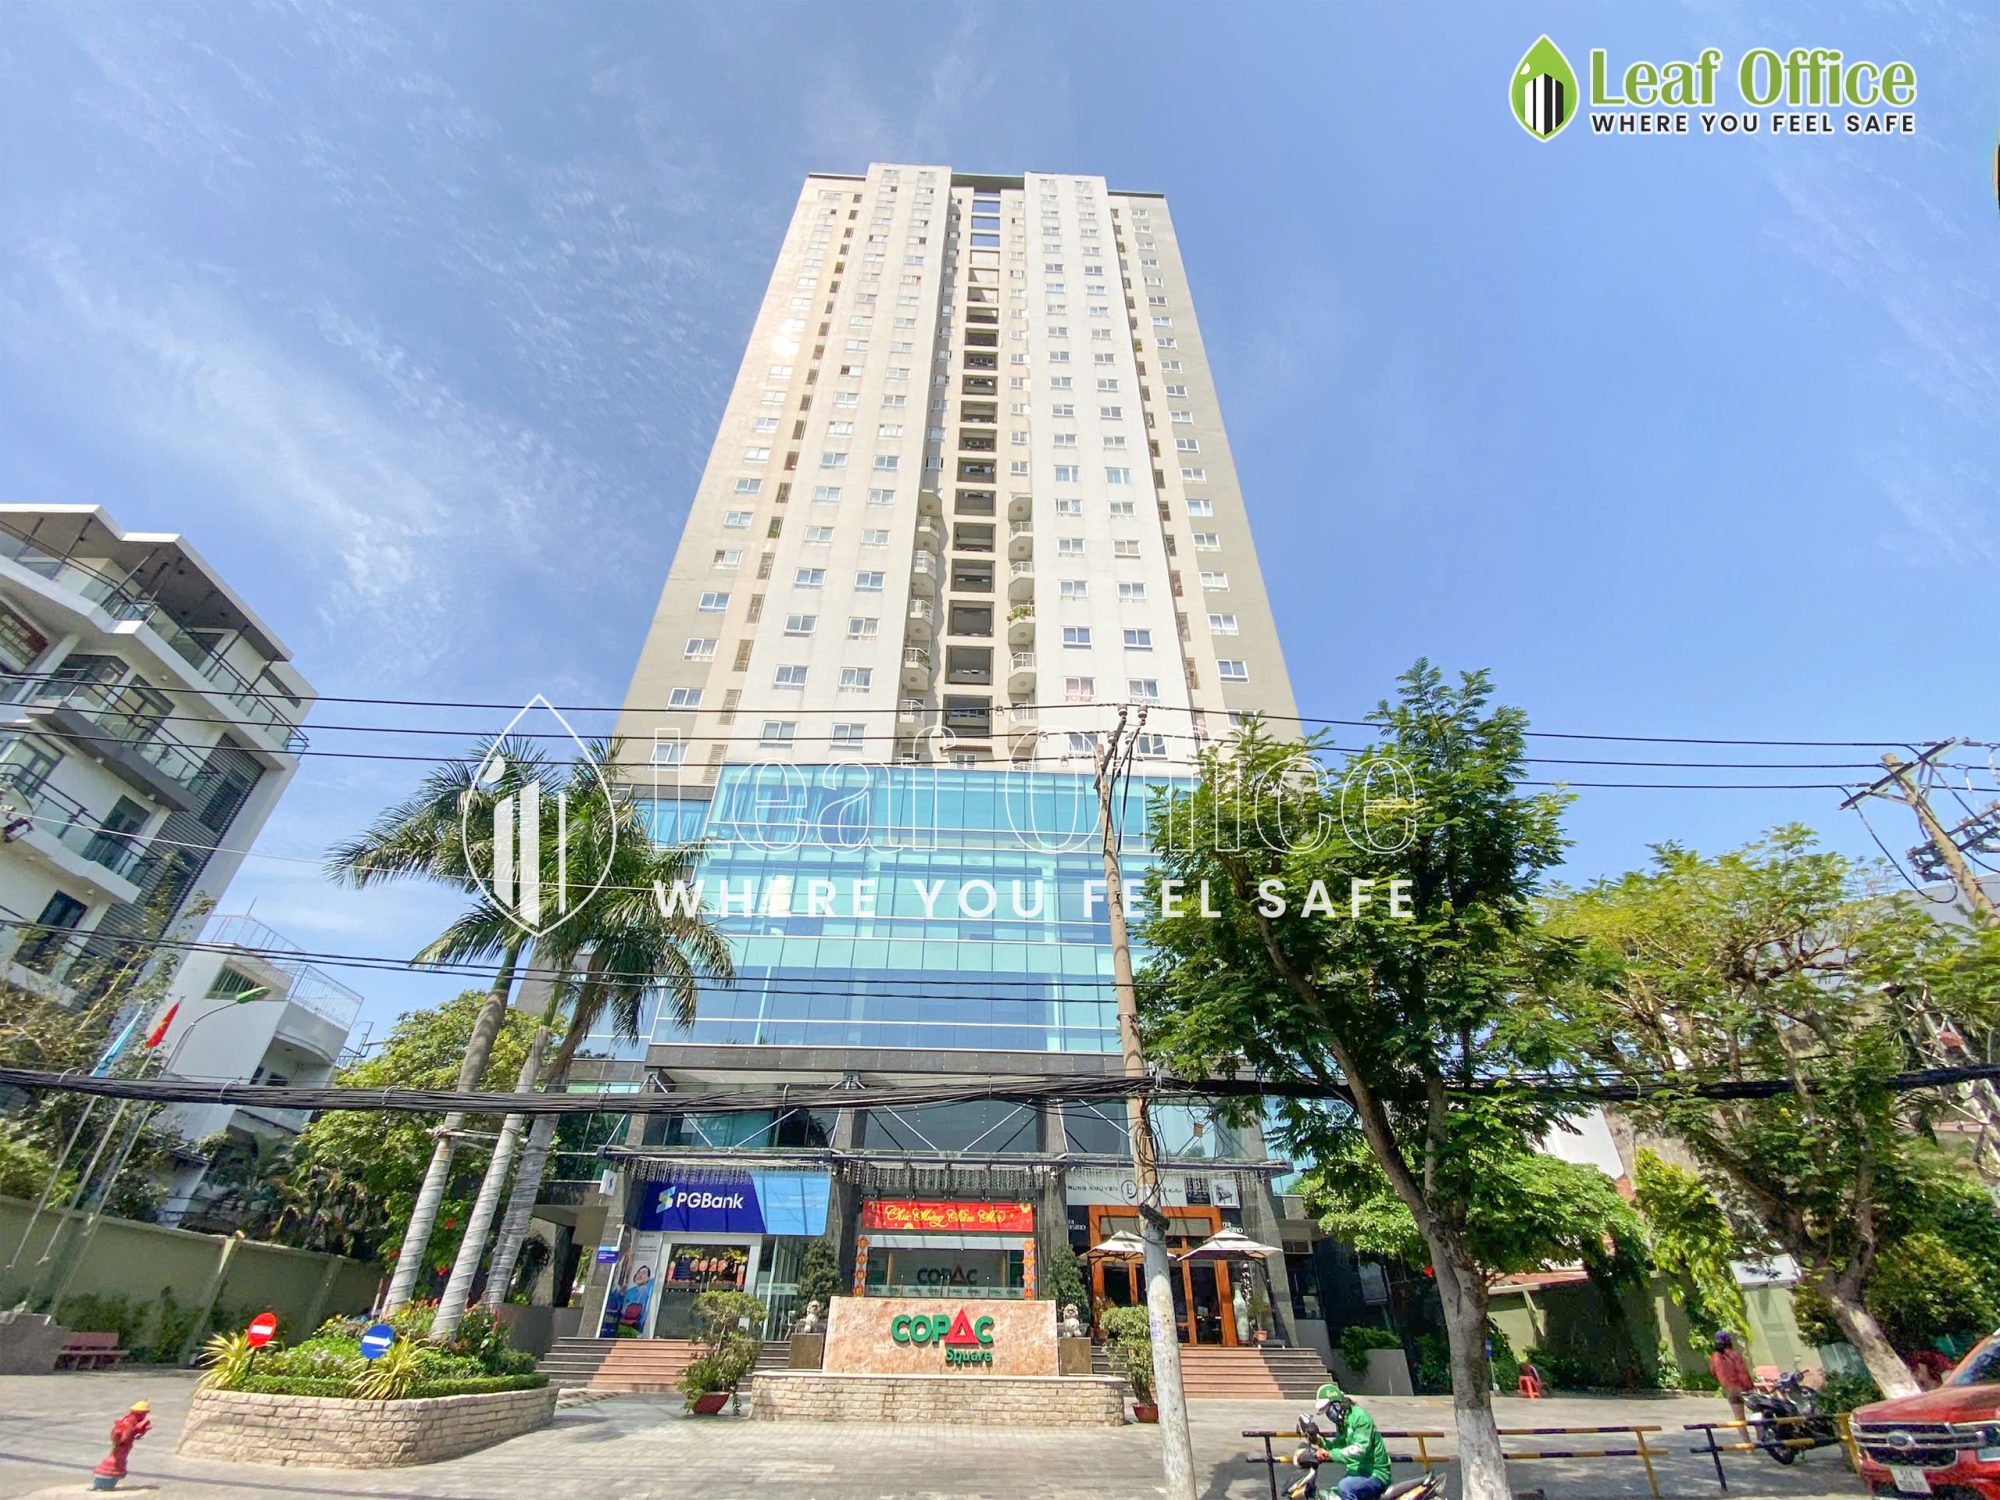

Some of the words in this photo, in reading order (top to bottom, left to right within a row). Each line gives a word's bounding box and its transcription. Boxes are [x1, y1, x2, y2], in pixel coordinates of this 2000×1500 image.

[676, 1192, 743, 1209] PGBank
[916, 1264, 978, 1285] COPAC
[891, 1308, 993, 1344] COPAC
[946, 1347, 992, 1364] Square
